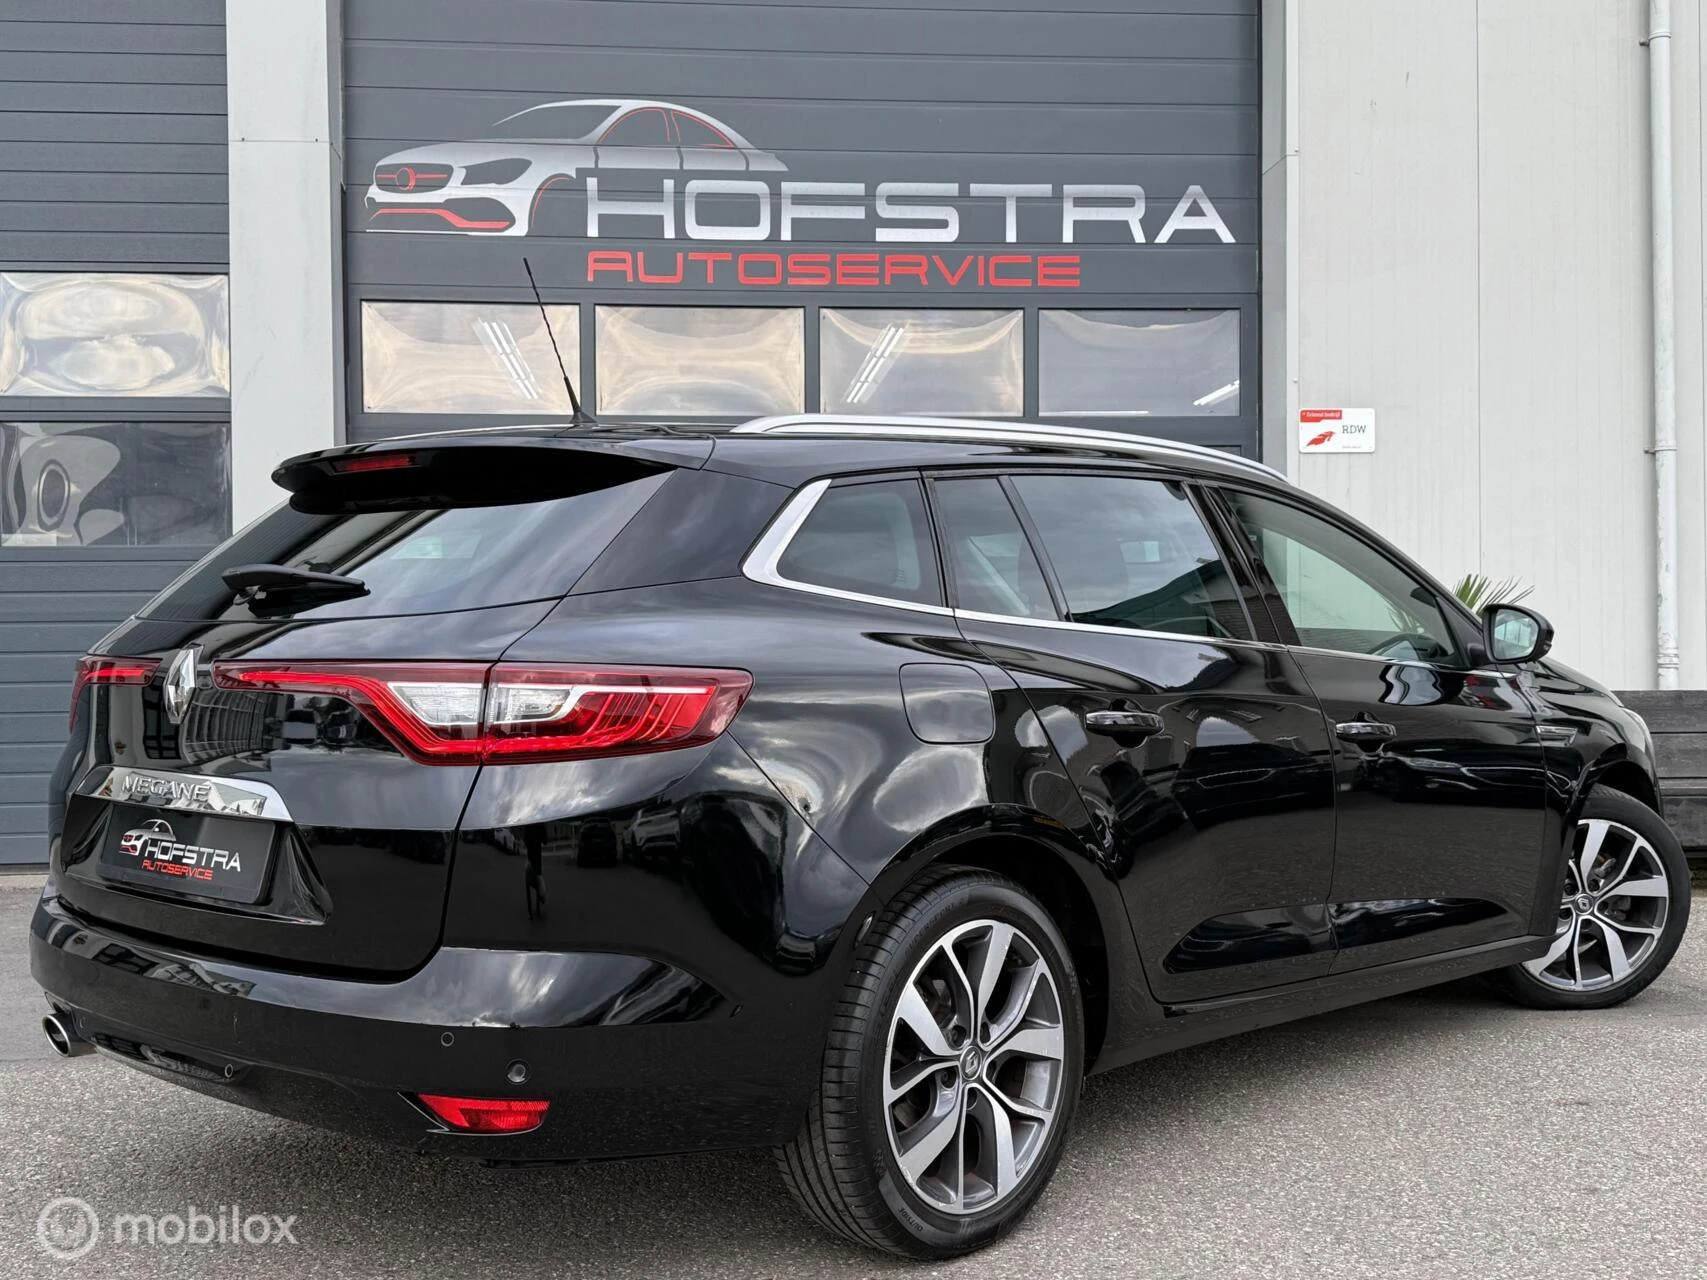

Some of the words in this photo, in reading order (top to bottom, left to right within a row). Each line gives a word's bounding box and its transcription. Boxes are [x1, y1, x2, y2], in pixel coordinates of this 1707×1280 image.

[586, 177, 1236, 244] HOFSTRA
[586, 250, 1081, 289] AUTOSERVICE
[1342, 424, 1366, 434] RDW
[121, 775, 211, 801] MEGANE
[141, 859, 214, 881] AUTOSERVICE
[143, 838, 241, 872] HOFSTRA
